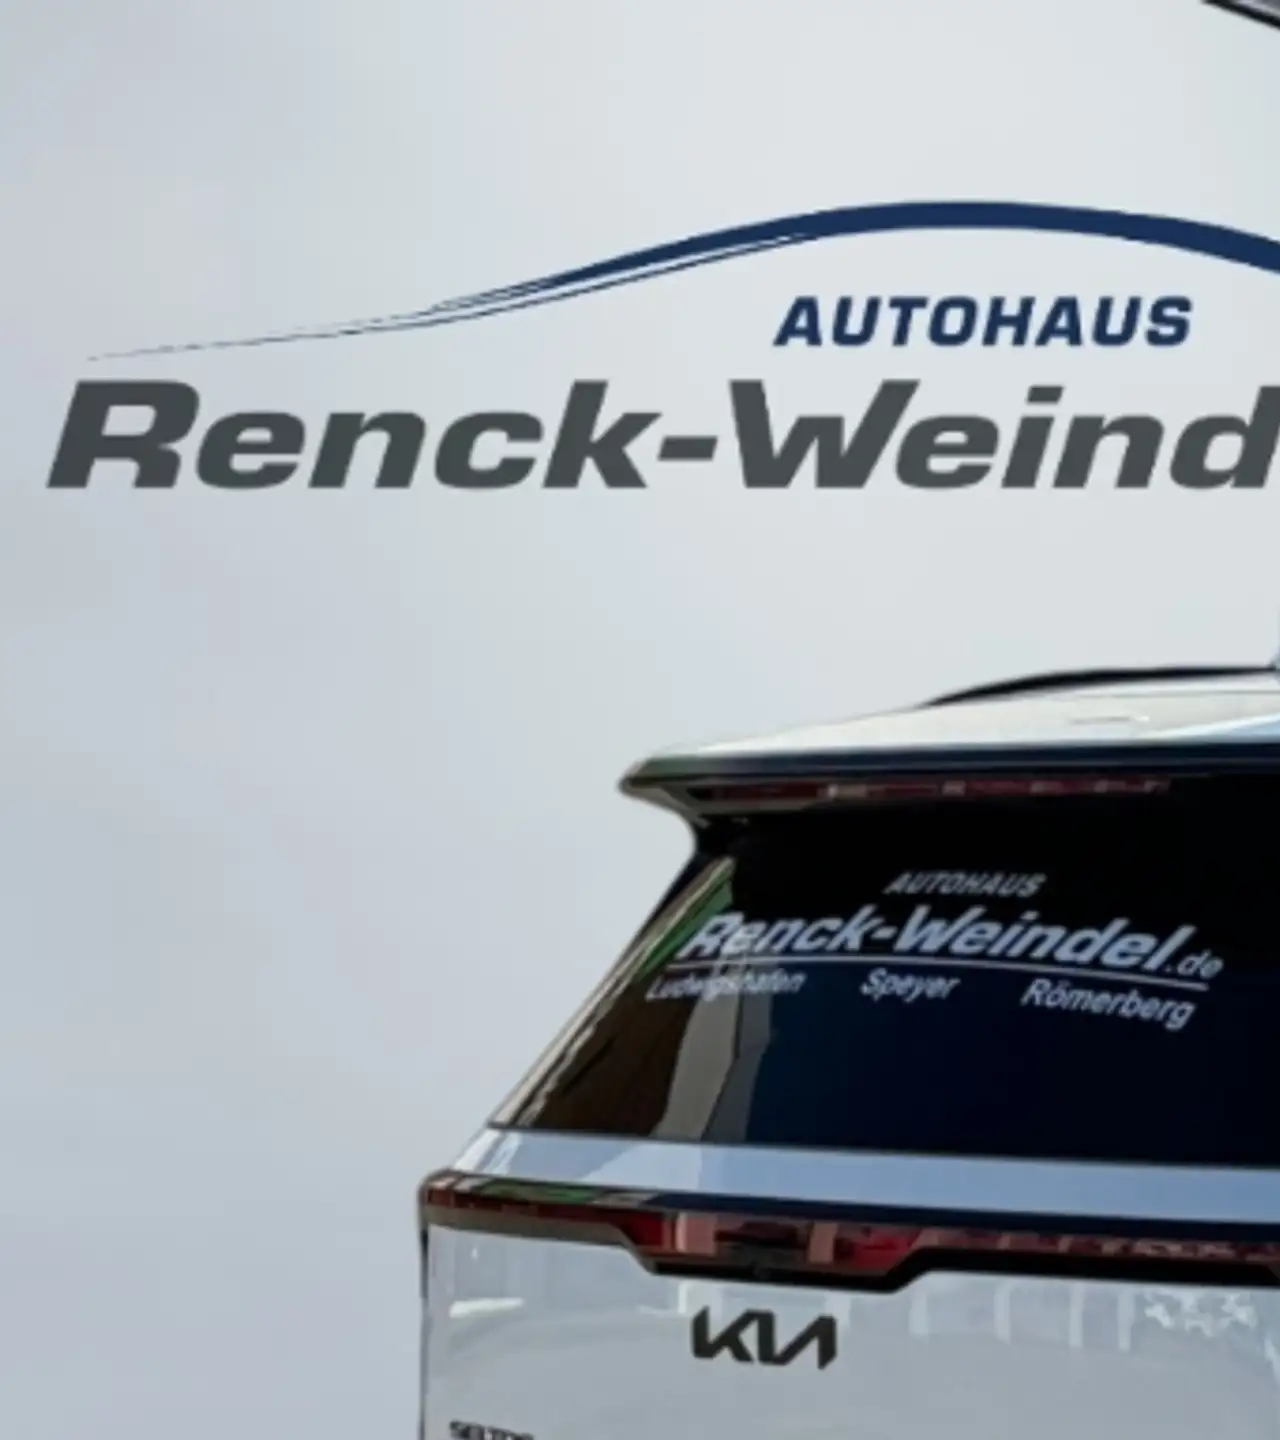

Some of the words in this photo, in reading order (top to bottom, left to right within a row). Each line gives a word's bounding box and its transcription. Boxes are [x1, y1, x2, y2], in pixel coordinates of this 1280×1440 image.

[774, 295, 1194, 348] AUTOHAUS
[882, 871, 1047, 898] AUTOHAUS
[676, 904, 1224, 979] Renck-Weindel.de
[859, 966, 962, 1003] Speyer
[1020, 976, 1195, 1031] Römerberg
